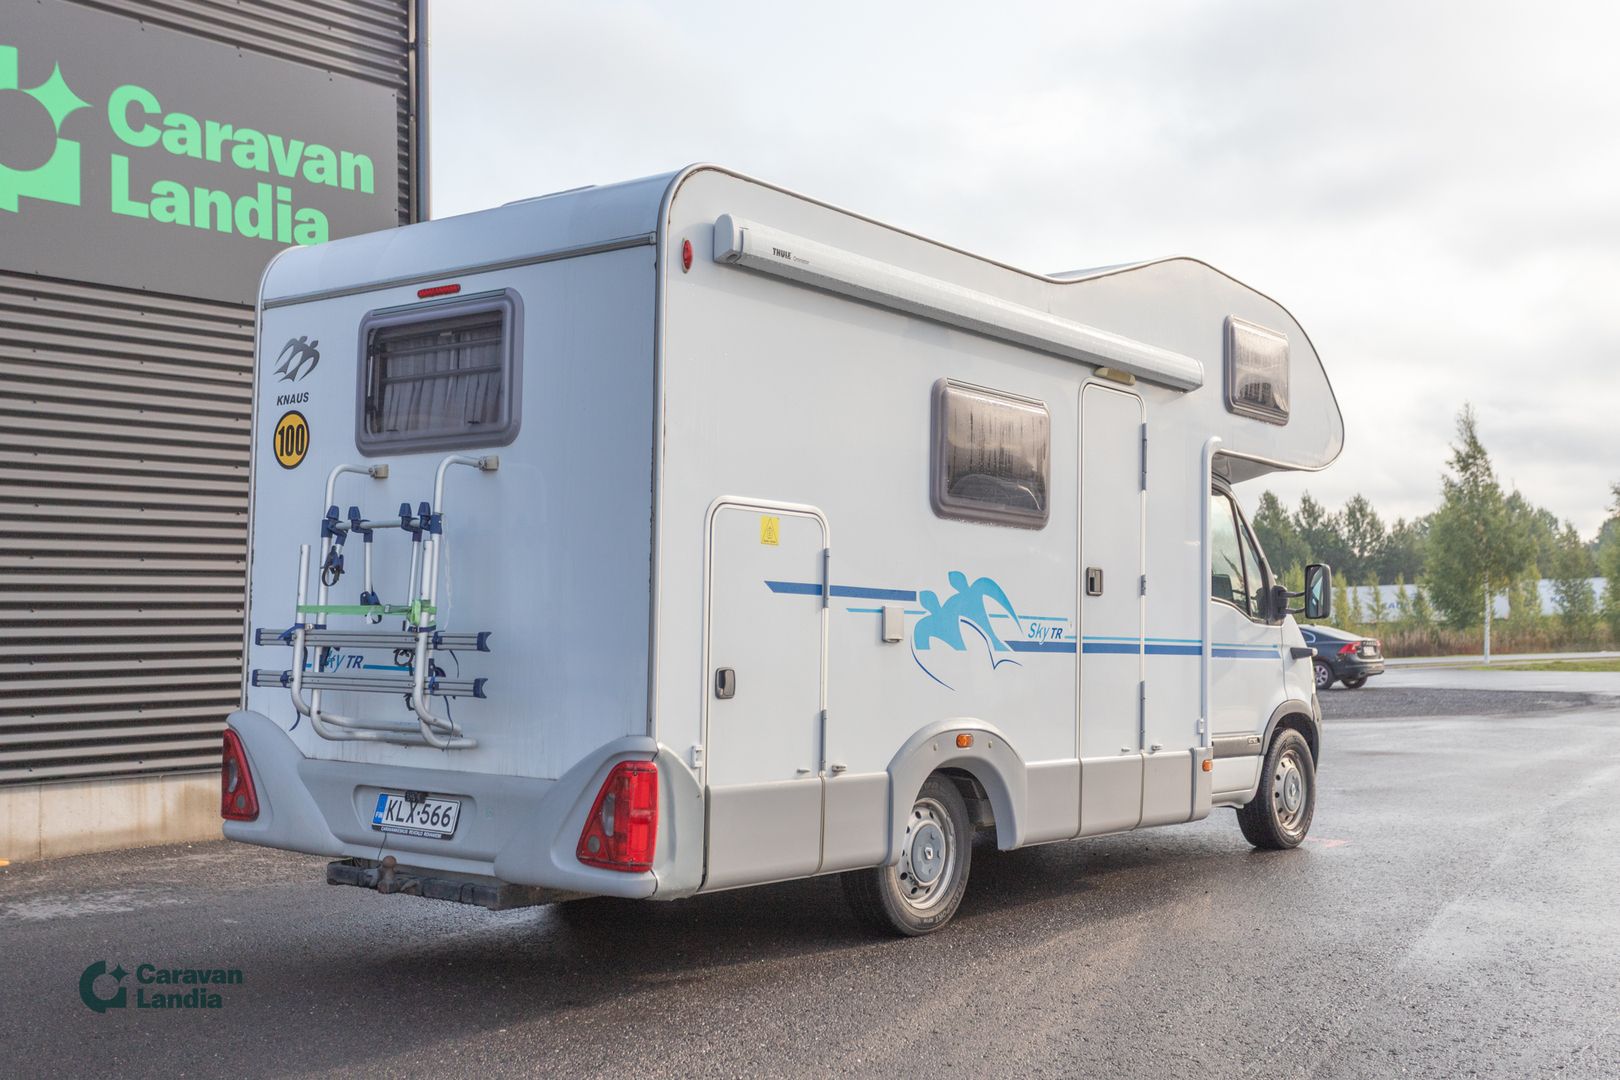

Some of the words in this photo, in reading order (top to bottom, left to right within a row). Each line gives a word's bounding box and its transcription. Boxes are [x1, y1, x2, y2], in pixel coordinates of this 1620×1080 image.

[107, 84, 375, 195] Caravan
[111, 153, 330, 247] Landia
[772, 247, 792, 260] THULE
[276, 391, 310, 406] KNAUS
[277, 423, 305, 457] 100
[1027, 622, 1050, 645] Sky
[1050, 627, 1064, 640] TR
[346, 655, 364, 669] TR
